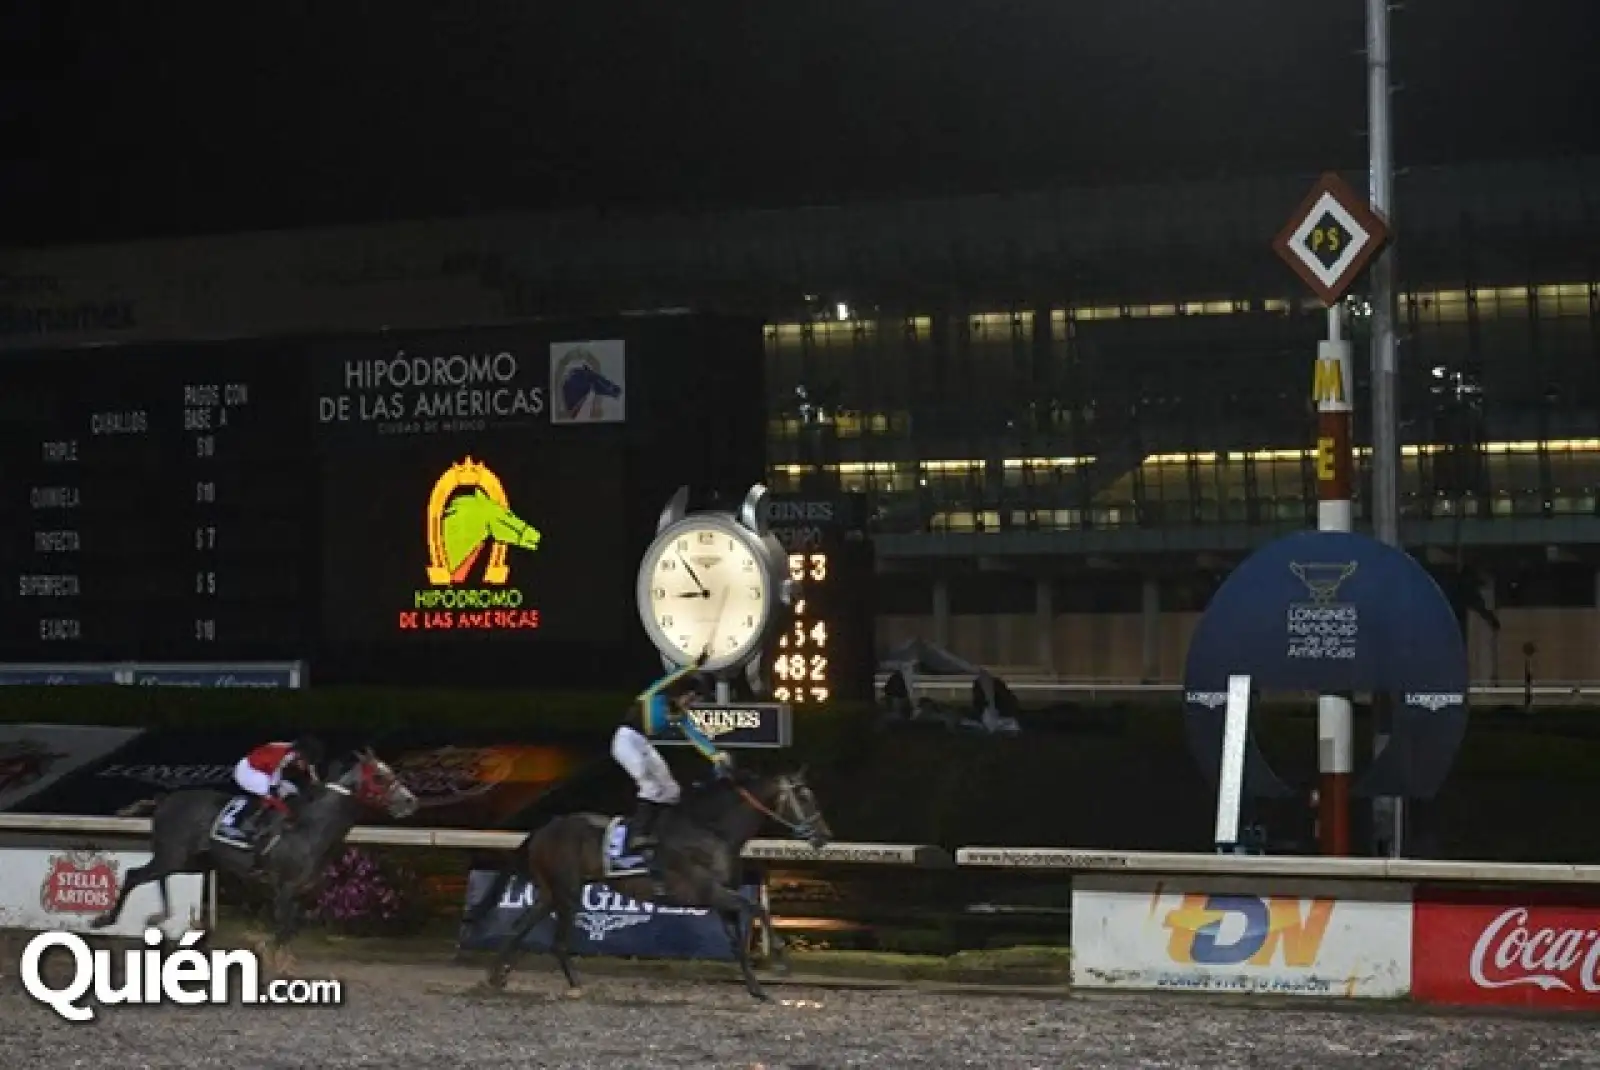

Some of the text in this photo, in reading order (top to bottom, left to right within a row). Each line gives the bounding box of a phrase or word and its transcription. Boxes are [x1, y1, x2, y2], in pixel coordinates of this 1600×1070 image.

[344, 351, 516, 389] HIPÓDROMO
[319, 383, 544, 422] DE LAS AMÉRICAS
[398, 611, 418, 629] DE
[423, 610, 453, 629] LAS
[56, 872, 109, 888] STELLA
[54, 889, 109, 906] ARTOIS
